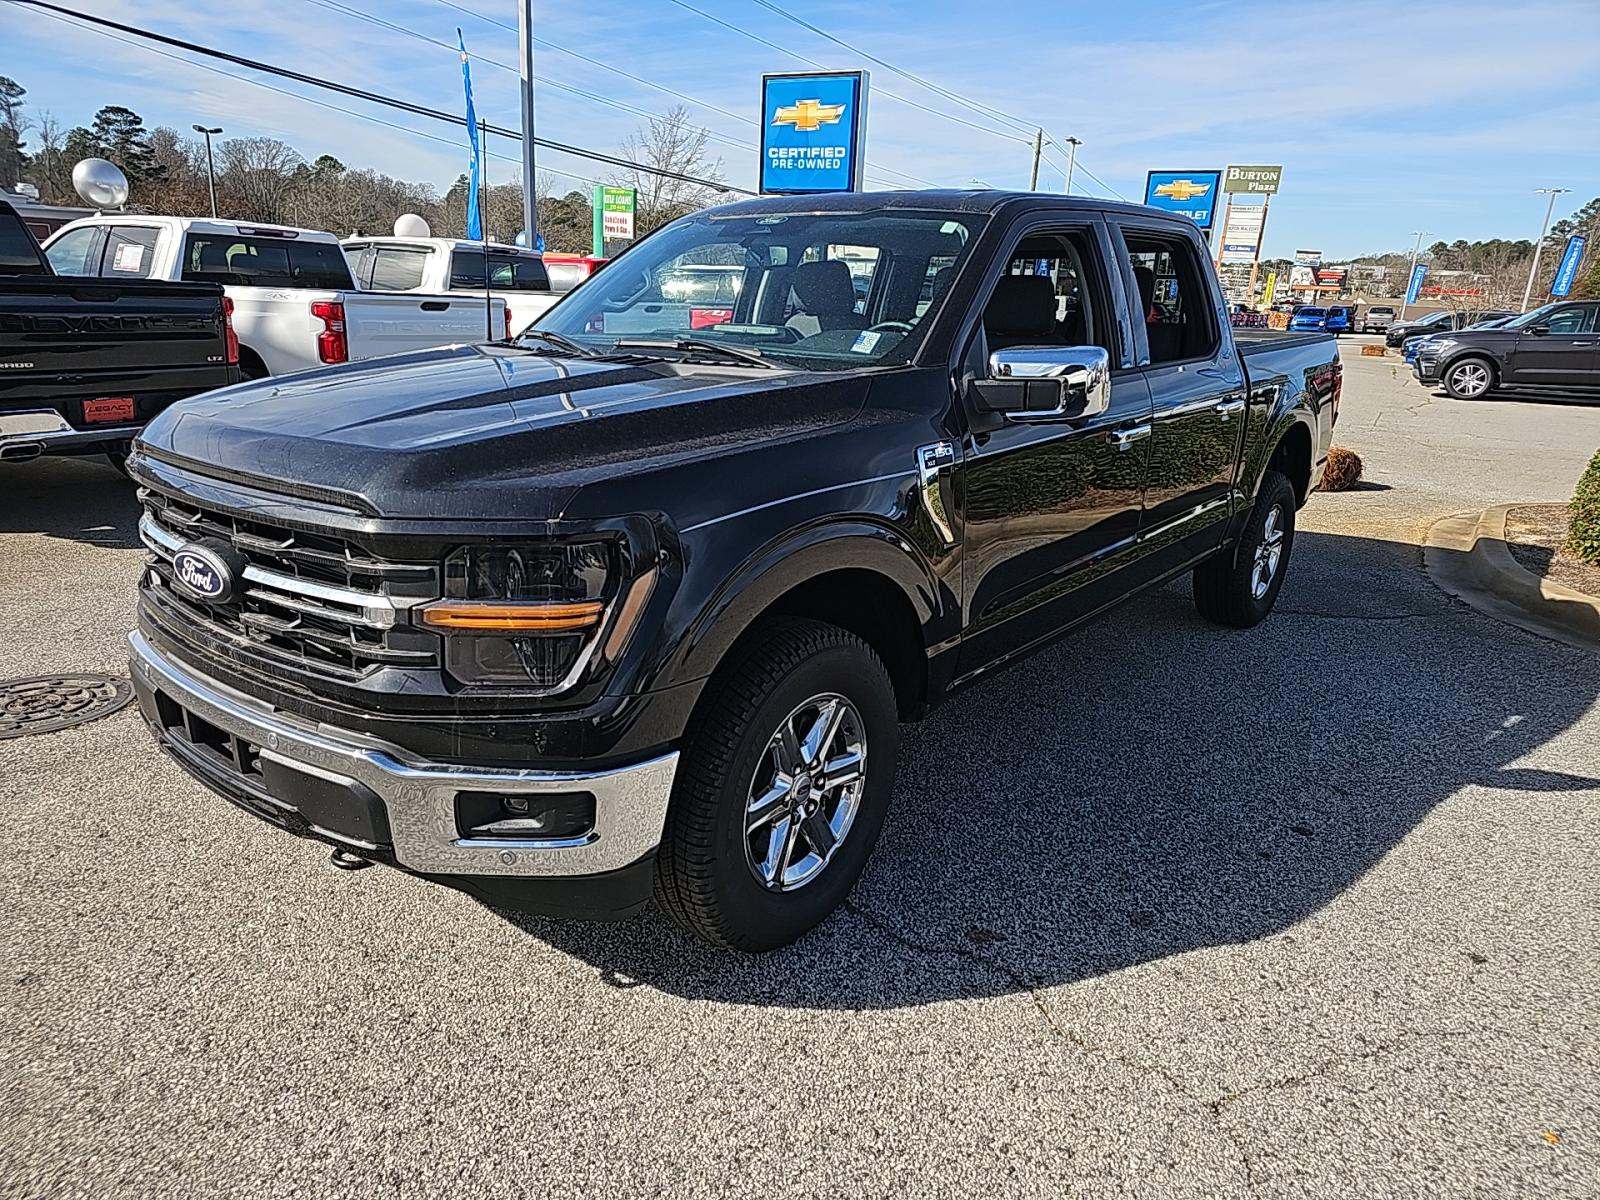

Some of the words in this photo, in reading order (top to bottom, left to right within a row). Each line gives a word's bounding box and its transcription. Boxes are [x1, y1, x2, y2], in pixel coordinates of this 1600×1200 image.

[768, 147, 846, 158] CERTIFIED
[772, 159, 841, 169] PRE-OWNED
[1229, 168, 1278, 180] BURTON
[1248, 182, 1276, 191] Plaza
[88, 404, 133, 413] LEGACY
[182, 556, 213, 591] Ford
